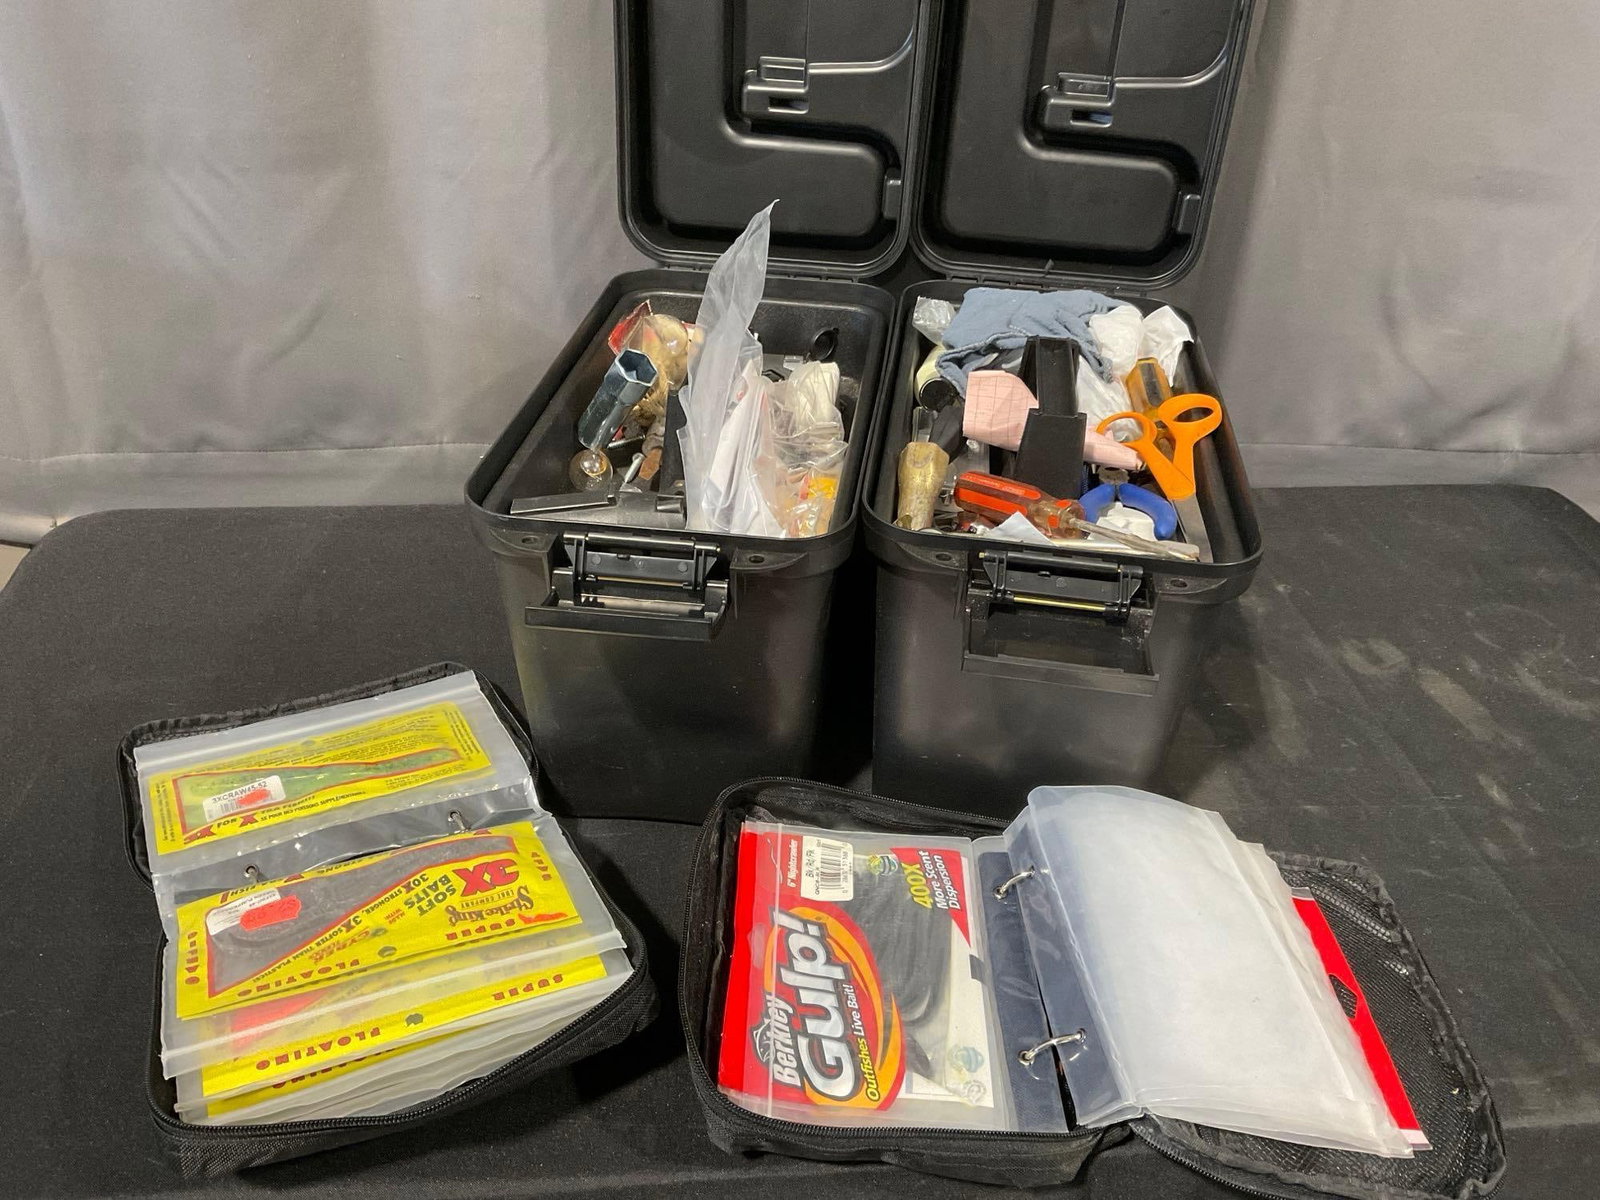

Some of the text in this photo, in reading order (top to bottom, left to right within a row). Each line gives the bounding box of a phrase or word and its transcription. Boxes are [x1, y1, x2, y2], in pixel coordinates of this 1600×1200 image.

[403, 873, 452, 910] BAITS
[416, 883, 457, 917] SOFT
[900, 863, 934, 910] 400X
[918, 850, 949, 910] More Scent
[933, 855, 961, 910] Dispersion
[444, 904, 486, 928] King
[491, 972, 564, 1001] SUPER
[773, 910, 856, 1098] Gulp!
[764, 993, 802, 1087] Berkley
[842, 983, 881, 1101] Outfishes Live Bait!
